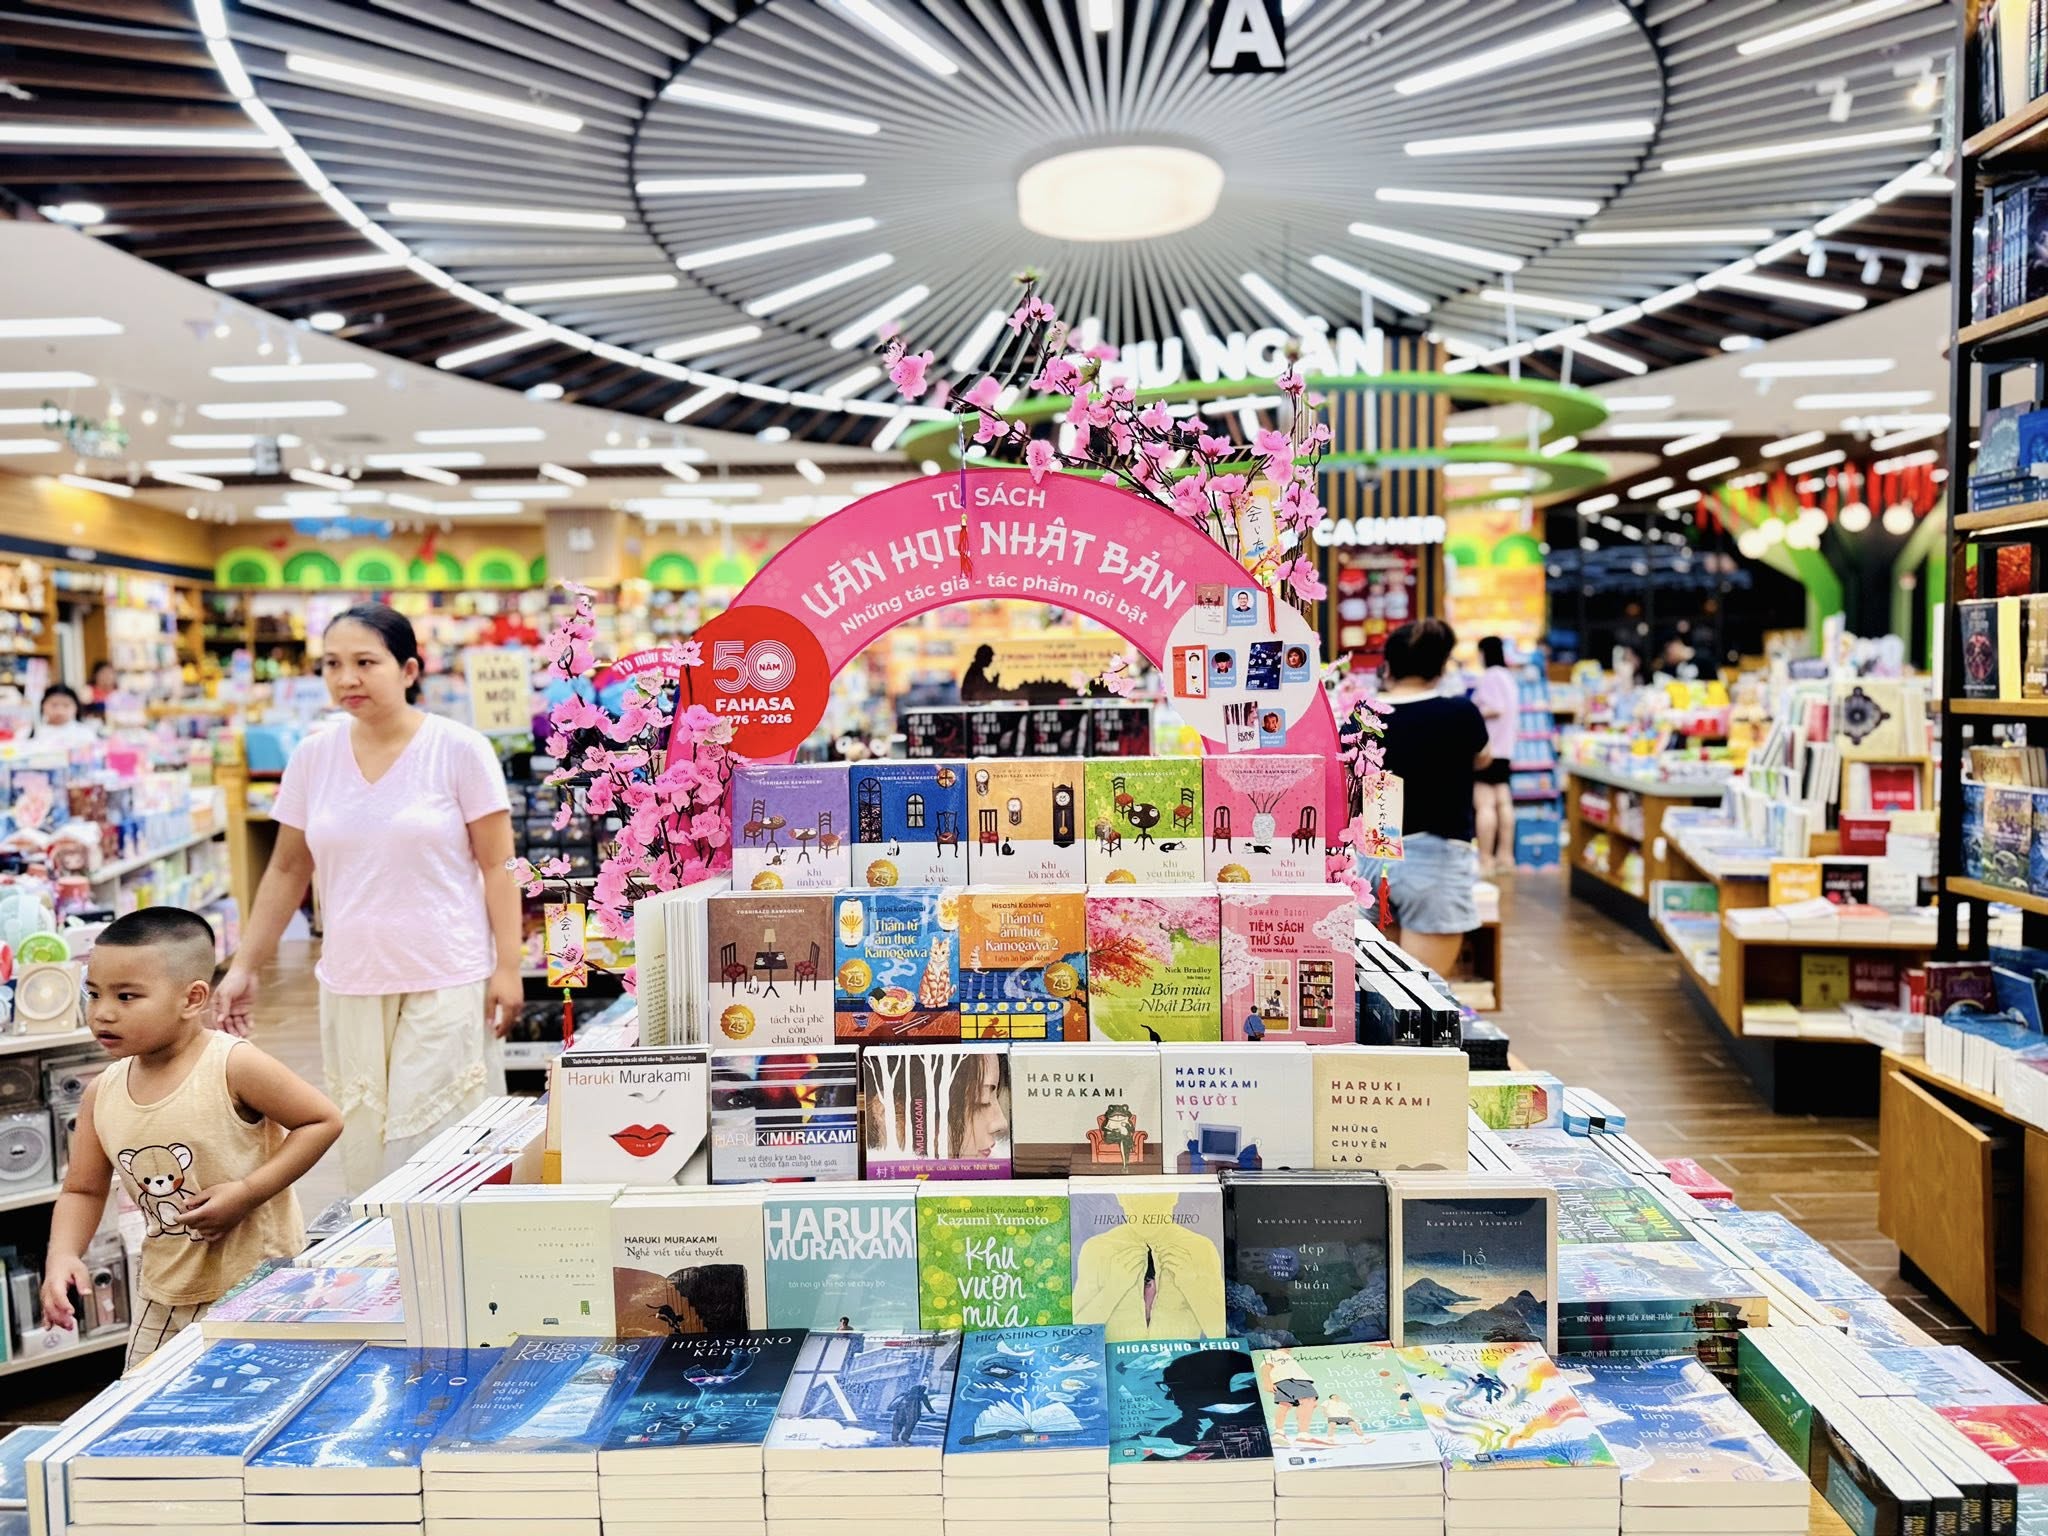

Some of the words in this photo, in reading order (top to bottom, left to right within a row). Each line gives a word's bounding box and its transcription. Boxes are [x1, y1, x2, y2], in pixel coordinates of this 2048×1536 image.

[1210, 0, 1285, 68] A
[932, 484, 963, 512] TỦ
[975, 482, 1046, 508] SÁCH
[801, 551, 887, 618] VĂN
[889, 526, 971, 574] HỌC
[980, 517, 1096, 566] NHẬT
[1098, 541, 1187, 610] BẢN
[840, 597, 903, 635] Những
[905, 584, 936, 603] tác
[941, 574, 969, 597] giả
[987, 572, 1017, 588] tác
[1022, 573, 1078, 597] phẩm
[1083, 587, 1115, 609] nổi
[1117, 601, 1148, 625] bật
[713, 640, 796, 694] 50
[758, 661, 781, 672] NĂM
[715, 697, 795, 712] FAHASA
[761, 714, 792, 724] 2026
[929, 865, 944, 874] Khi
[1041, 861, 1056, 870] Khi
[1280, 859, 1296, 868] Khi
[806, 868, 822, 878] Khi
[992, 902, 1017, 910] Hisashi
[1018, 902, 1051, 910] Kashiwai
[1248, 907, 1278, 917] Sawako
[1000, 912, 1030, 925] Thám
[1032, 911, 1043, 925] tử
[873, 919, 904, 932] Thám
[905, 917, 919, 931] tử
[1249, 920, 1274, 934] TIỆM
[1278, 920, 1304, 933] SÁCH
[1000, 925, 1017, 938] ẩm
[1019, 926, 1042, 939] thực
[874, 932, 892, 945] ẩm
[894, 932, 917, 945] thực
[1250, 933, 1271, 945] THỨ
[1274, 934, 1294, 945] SÁU
[985, 939, 1049, 953] Kamogawa
[1051, 939, 1059, 950] 2
[865, 946, 928, 960] Kamogawa
[1165, 966, 1182, 974] Nick
[1184, 966, 1212, 976] Bradley
[1151, 982, 1180, 997] Bốn
[1182, 983, 1210, 996] mùa
[789, 1004, 806, 1013] Khi
[1139, 999, 1177, 1014] Nhật
[1179, 999, 1210, 1013] Bản
[770, 1014, 787, 1024] tách
[792, 1014, 804, 1024] cà
[806, 1013, 825, 1026] phê
[788, 1025, 806, 1035] còn
[771, 1034, 796, 1045] chưa
[796, 1034, 824, 1046] nguội
[568, 1070, 614, 1085] Haruki
[620, 1068, 690, 1084] Murakami
[1176, 1067, 1233, 1075] HARUKI
[1027, 1073, 1095, 1083] HARUKI
[1176, 1080, 1258, 1089] MURAKAMI
[1332, 1080, 1402, 1091] HARUKI
[1027, 1088, 1124, 1097] MURAKAMI
[1176, 1094, 1238, 1106] NGƯỜI
[1332, 1095, 1431, 1107] MURAKAMI
[1176, 1110, 1199, 1121] TV
[915, 1098, 923, 1153] MURAKAMI
[937, 1214, 990, 1226] Kazumi
[993, 1214, 1049, 1226] Yumoto
[1093, 1214, 1138, 1226] HIRANO
[1142, 1213, 1200, 1225] KEIICHIRO
[1257, 1217, 1307, 1225] Kawabata
[1426, 1219, 1474, 1227] Kawabata
[1479, 1219, 1523, 1227] Yasunari
[624, 1236, 661, 1244] HARUKI
[664, 1235, 717, 1244] MURAKAMI
[625, 1246, 650, 1259] Nghề
[653, 1247, 670, 1257] viết
[674, 1246, 692, 1257] tiểu
[694, 1246, 724, 1258] thuyết
[965, 1236, 1020, 1270] Khu
[1462, 1247, 1487, 1266] hồ
[1304, 1262, 1319, 1272] và
[958, 1271, 1026, 1300] vườn
[1294, 1280, 1329, 1290] buồn
[962, 1301, 1029, 1328] mùa
[975, 1330, 1047, 1342] HIGASHINO
[1052, 1328, 1093, 1337] KEIGO
[521, 1340, 640, 1355] Higashino
[672, 1336, 792, 1350] HIGASHINO
[1116, 1343, 1192, 1354] HIGASHINO
[1200, 1341, 1240, 1351] KEIGO
[513, 1350, 581, 1363] Keigo
[693, 1346, 761, 1357] KEIGO
[1341, 1350, 1380, 1360] Keigo
[1427, 1347, 1516, 1357] HIGASHINO
[1451, 1354, 1500, 1362] KEIGO
[1326, 1365, 1359, 1378] hồi
[1324, 1376, 1384, 1390] chúng
[507, 1388, 525, 1396] lập
[1345, 1389, 1363, 1399] ta
[1371, 1389, 1385, 1398] là
[493, 1402, 525, 1410] tuyết
[1657, 1441, 1704, 1451] song
[1665, 1451, 1711, 1461] song
